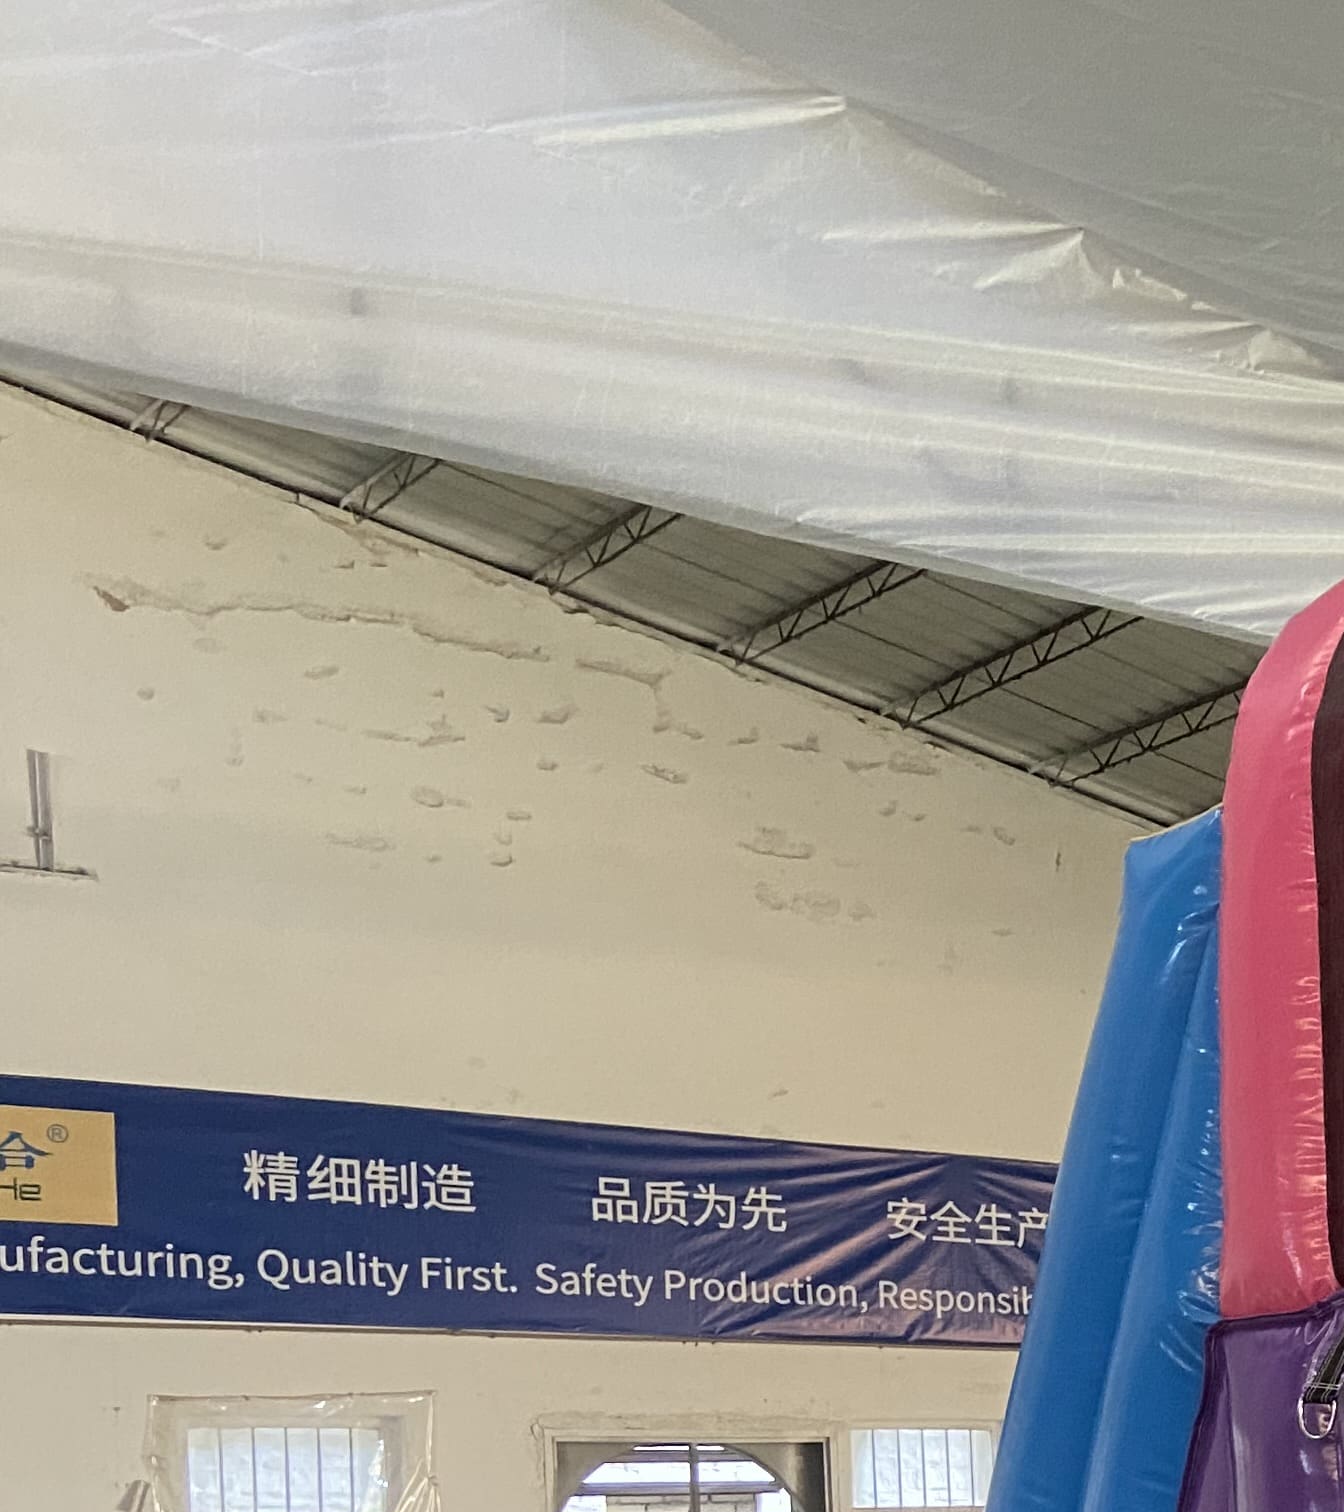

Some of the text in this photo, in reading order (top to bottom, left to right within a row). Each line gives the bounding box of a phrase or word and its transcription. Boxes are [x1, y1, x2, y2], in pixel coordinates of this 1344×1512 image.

[243, 1149, 1049, 1249] 精细制造 品质为先 安全生产
[0, 1235, 245, 1290] ufacturing,
[257, 1249, 409, 1297] Quality
[421, 1257, 518, 1293] First.
[535, 1262, 654, 1307] Safety
[664, 1269, 869, 1313] Production,
